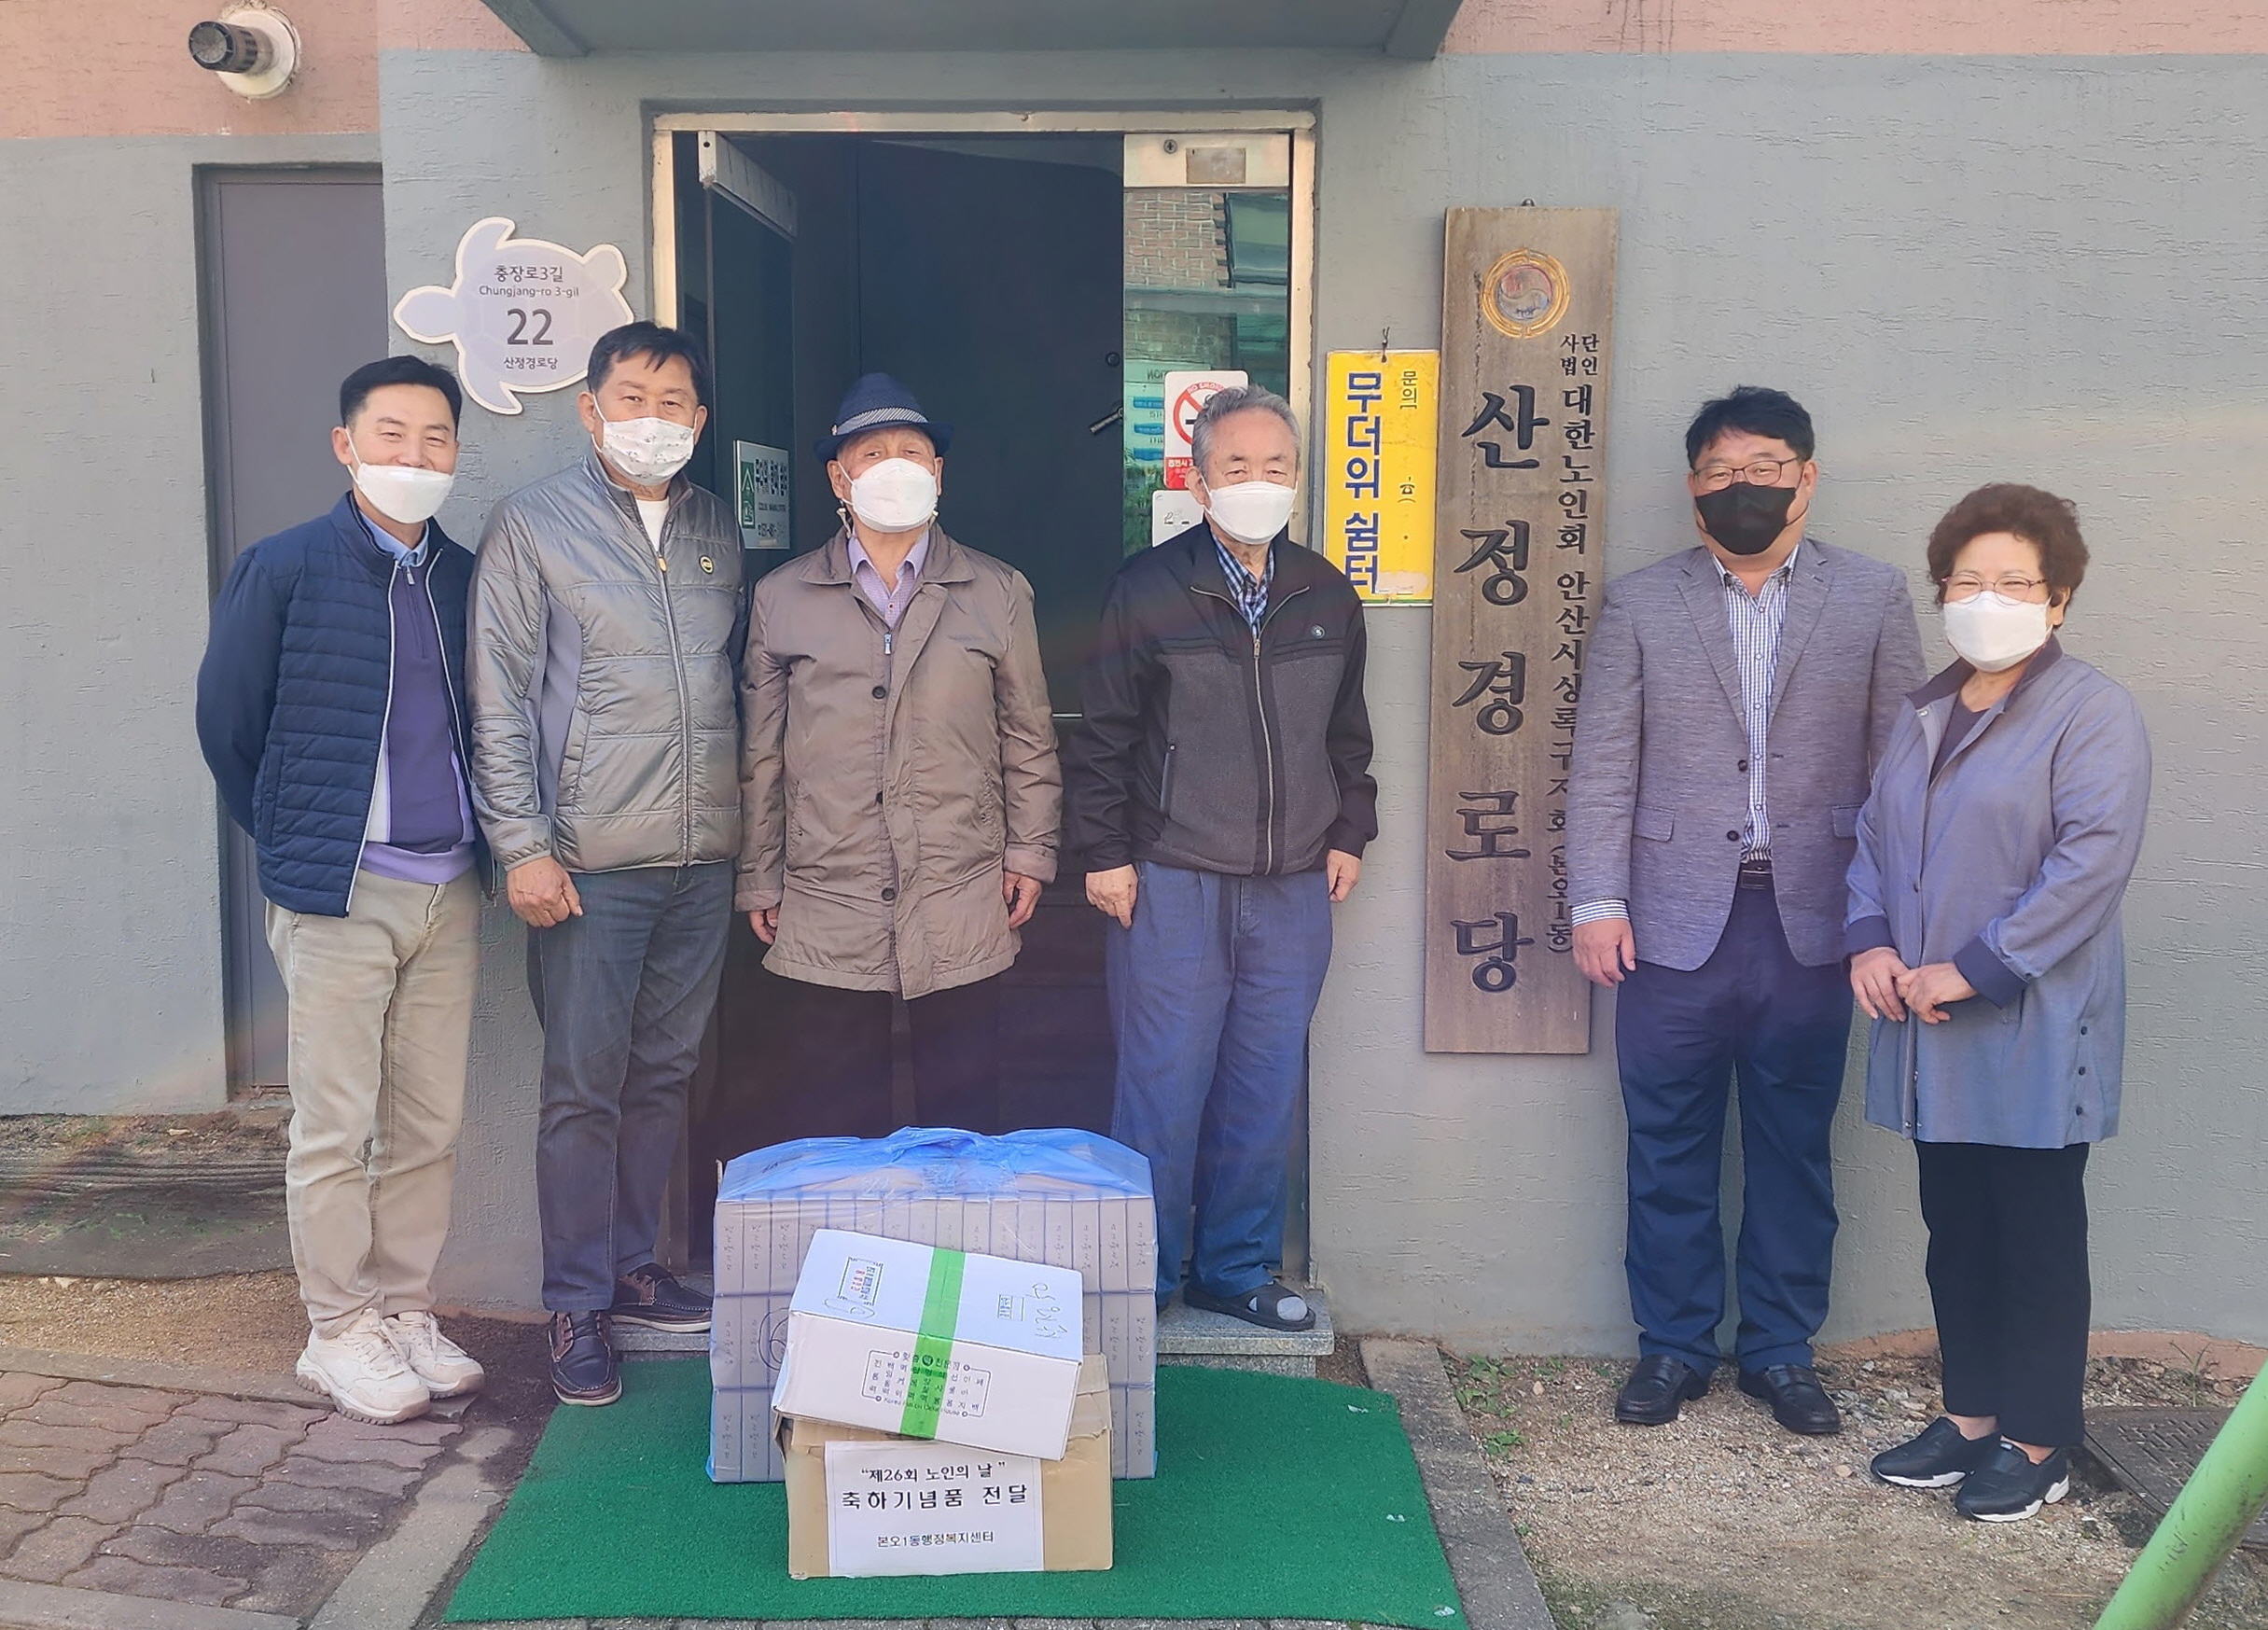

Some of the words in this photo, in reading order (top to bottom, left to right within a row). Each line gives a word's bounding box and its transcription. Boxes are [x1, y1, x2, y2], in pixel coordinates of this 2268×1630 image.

[494, 266, 564, 282] 충장로3길
[479, 286, 551, 298] Chungjang-ro
[555, 286, 579, 298] 3-gil
[507, 308, 553, 345] 22
[504, 357, 558, 369] 산정경로당
[1345, 372, 1382, 499] 무더위
[1555, 384, 1595, 554] 대한노인회
[1344, 512, 1379, 594] 쉼터
[925, 1465, 969, 1481] 노인의
[842, 1488, 963, 1510] 축하기념품
[982, 1484, 1027, 1505] 전달
[878, 1531, 995, 1548] 본오1동행정복지센터
